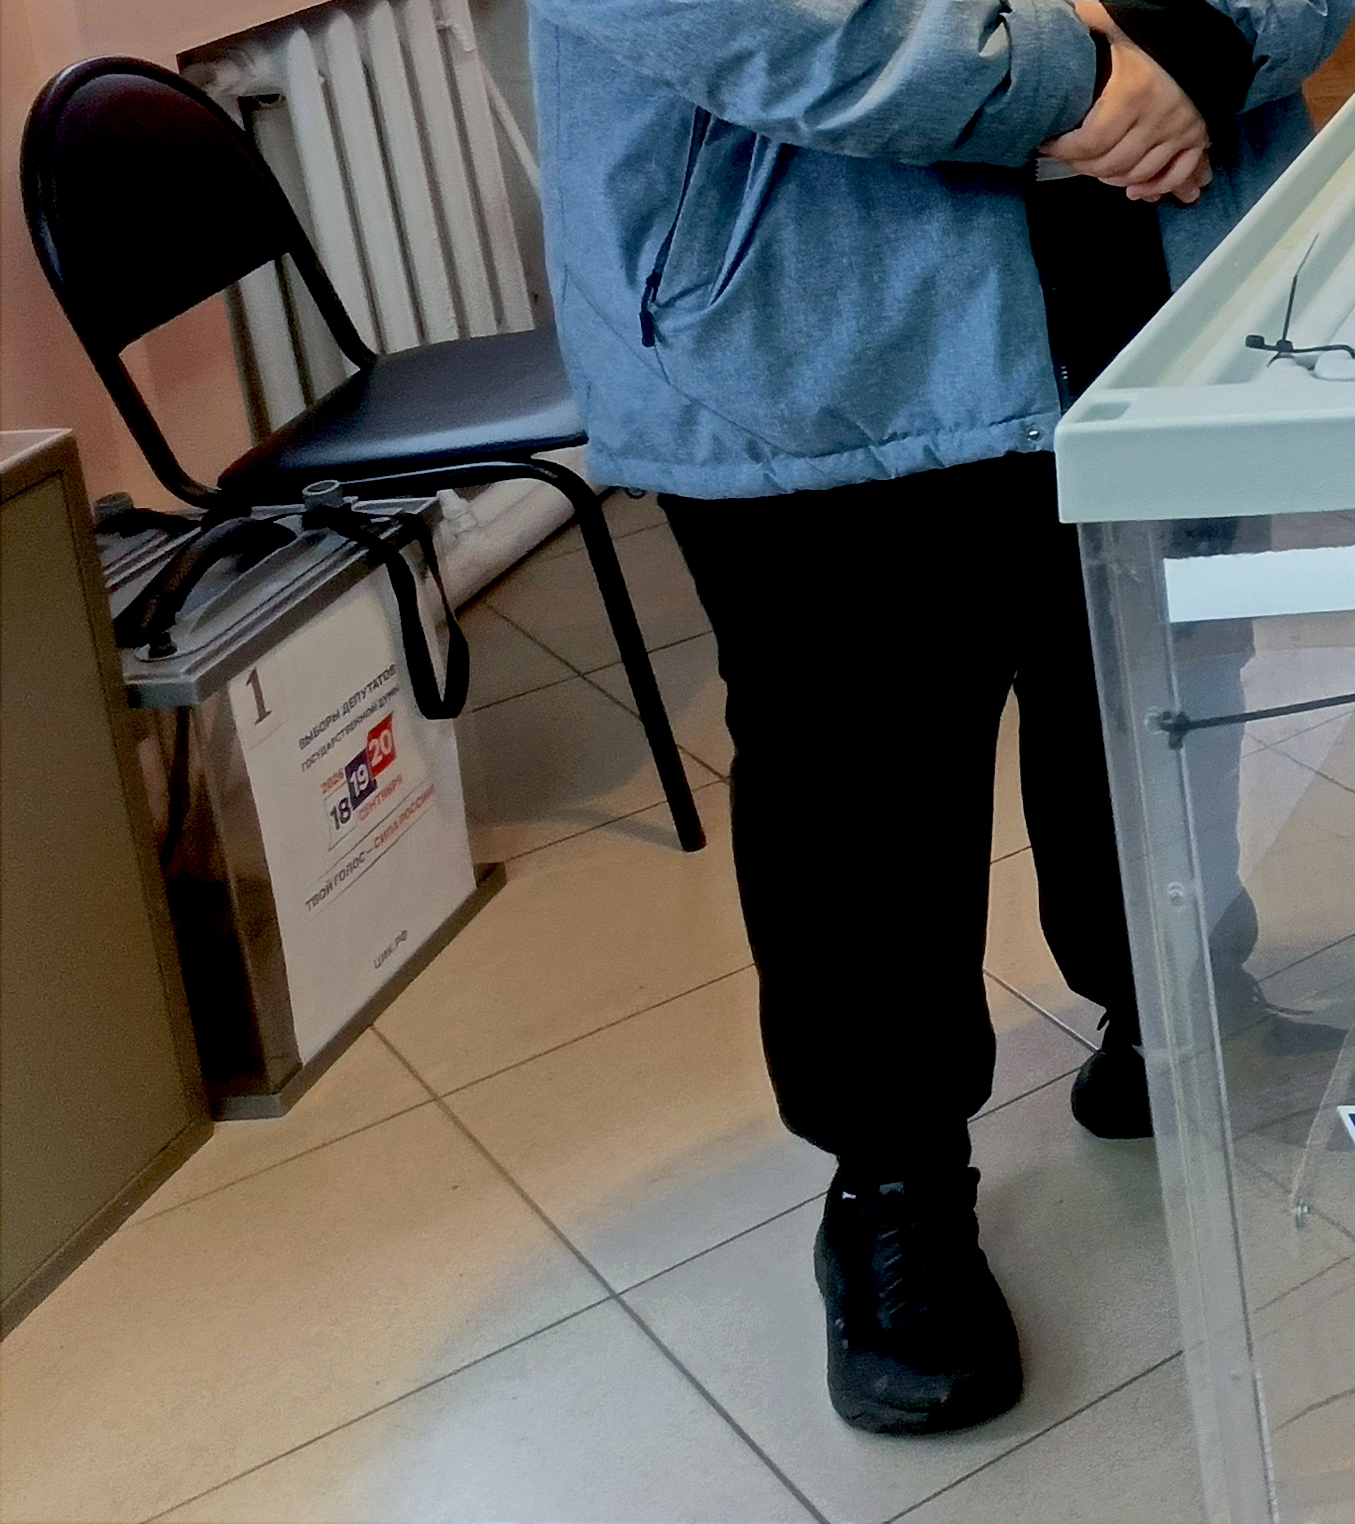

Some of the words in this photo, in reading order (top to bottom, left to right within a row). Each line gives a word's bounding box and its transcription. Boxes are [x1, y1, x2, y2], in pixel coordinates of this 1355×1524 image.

[245, 667, 273, 724] 1
[299, 710, 341, 750] ВЫБОРЫ
[369, 731, 392, 766] 20
[350, 764, 370, 798] 19
[329, 799, 350, 830] 18
[306, 879, 333, 912] ТВОЙ
[334, 851, 365, 887] ГОЛОС
